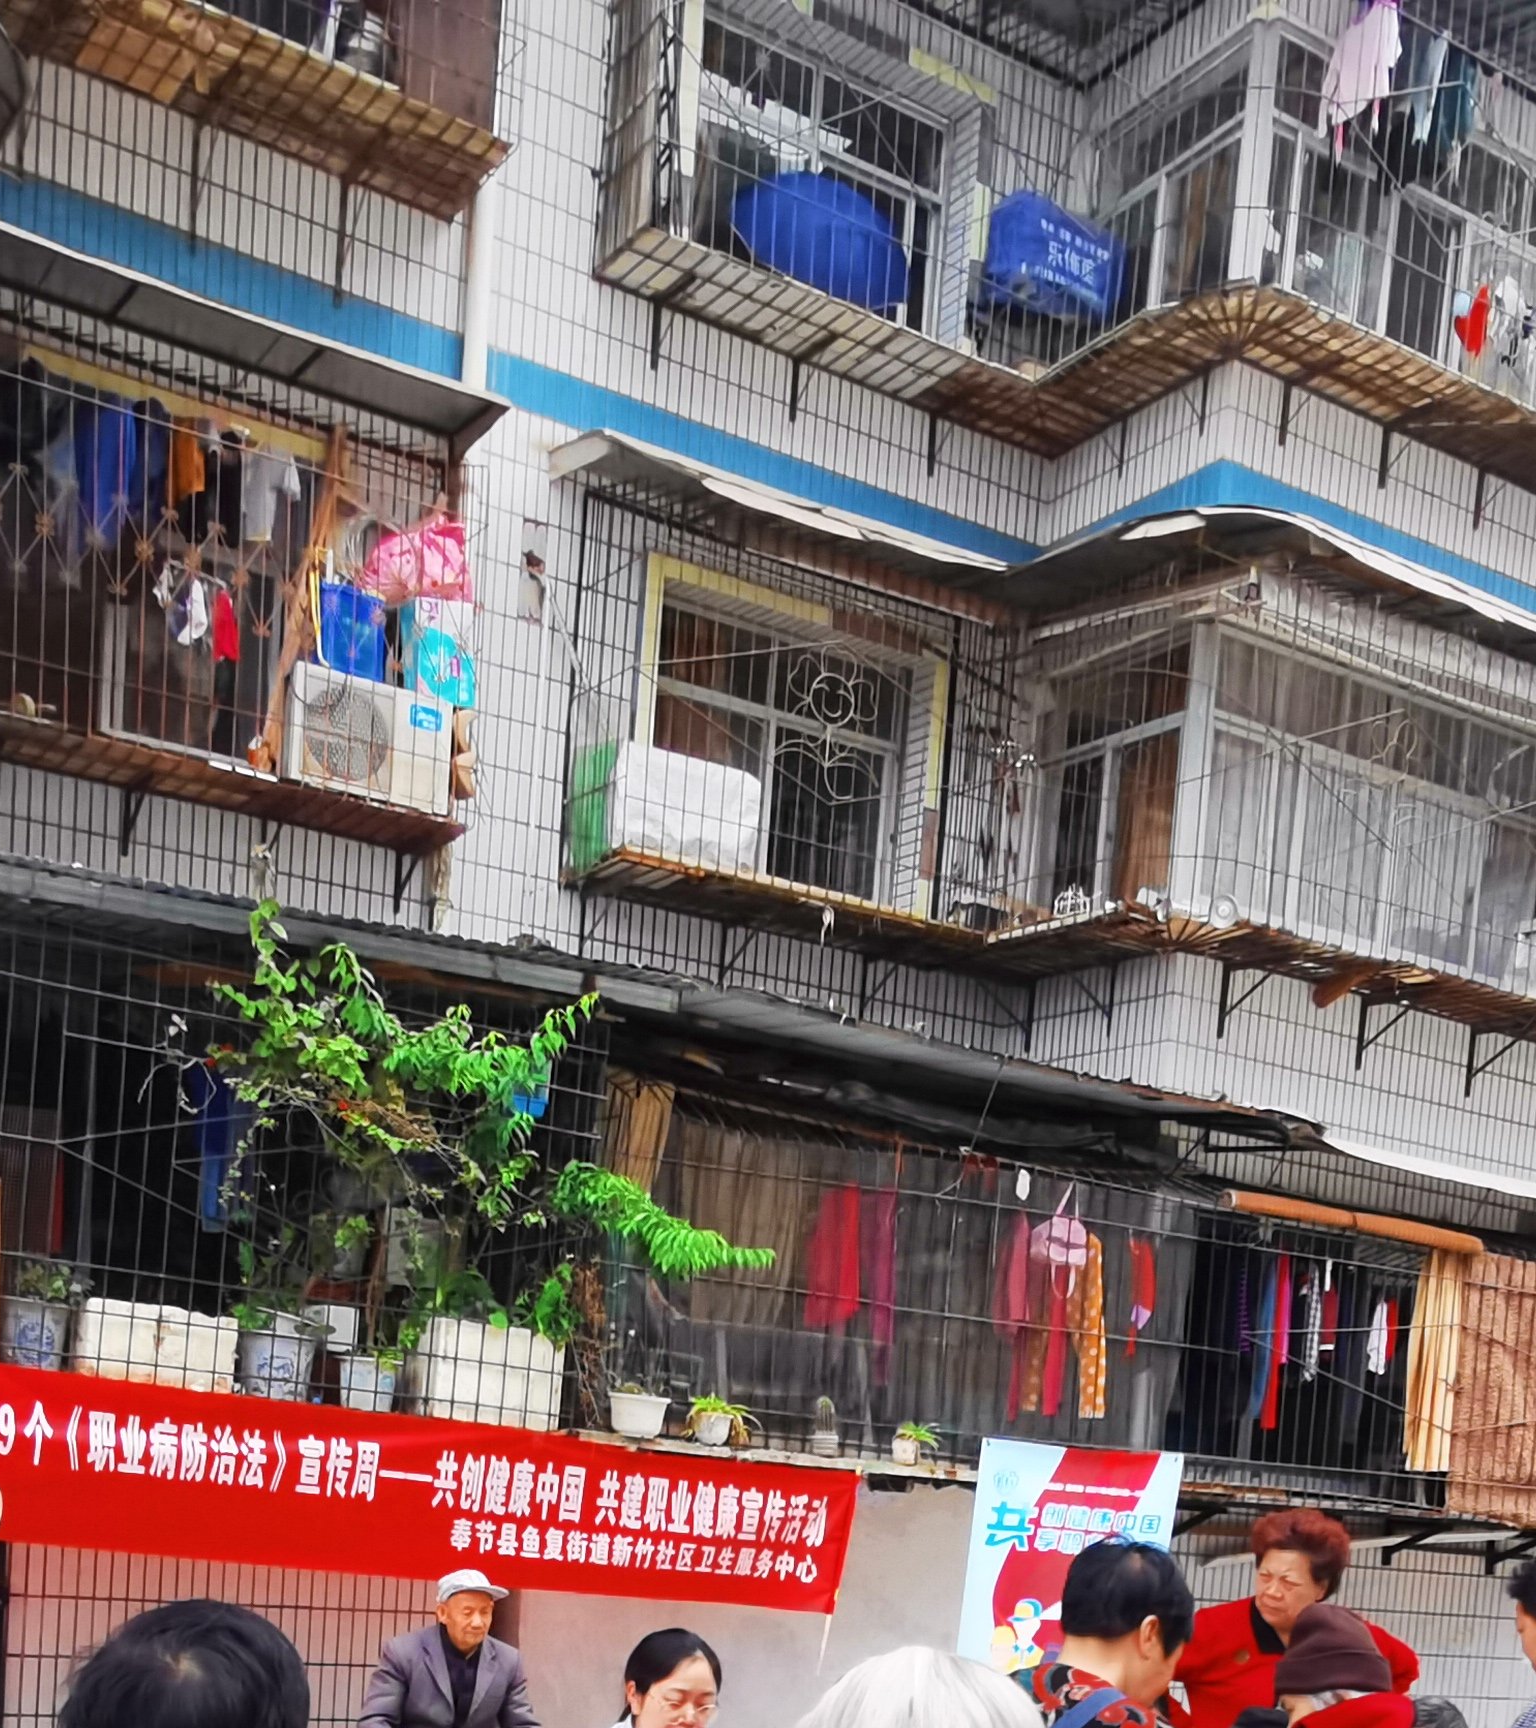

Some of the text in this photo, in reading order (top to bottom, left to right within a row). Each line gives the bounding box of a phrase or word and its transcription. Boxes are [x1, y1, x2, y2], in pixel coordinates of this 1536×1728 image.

[594, 1469, 828, 1548] 共建职业健康宣传活动
[450, 1518, 818, 1584] 奉节县鱼复街道新竹社区卫生服务中心
